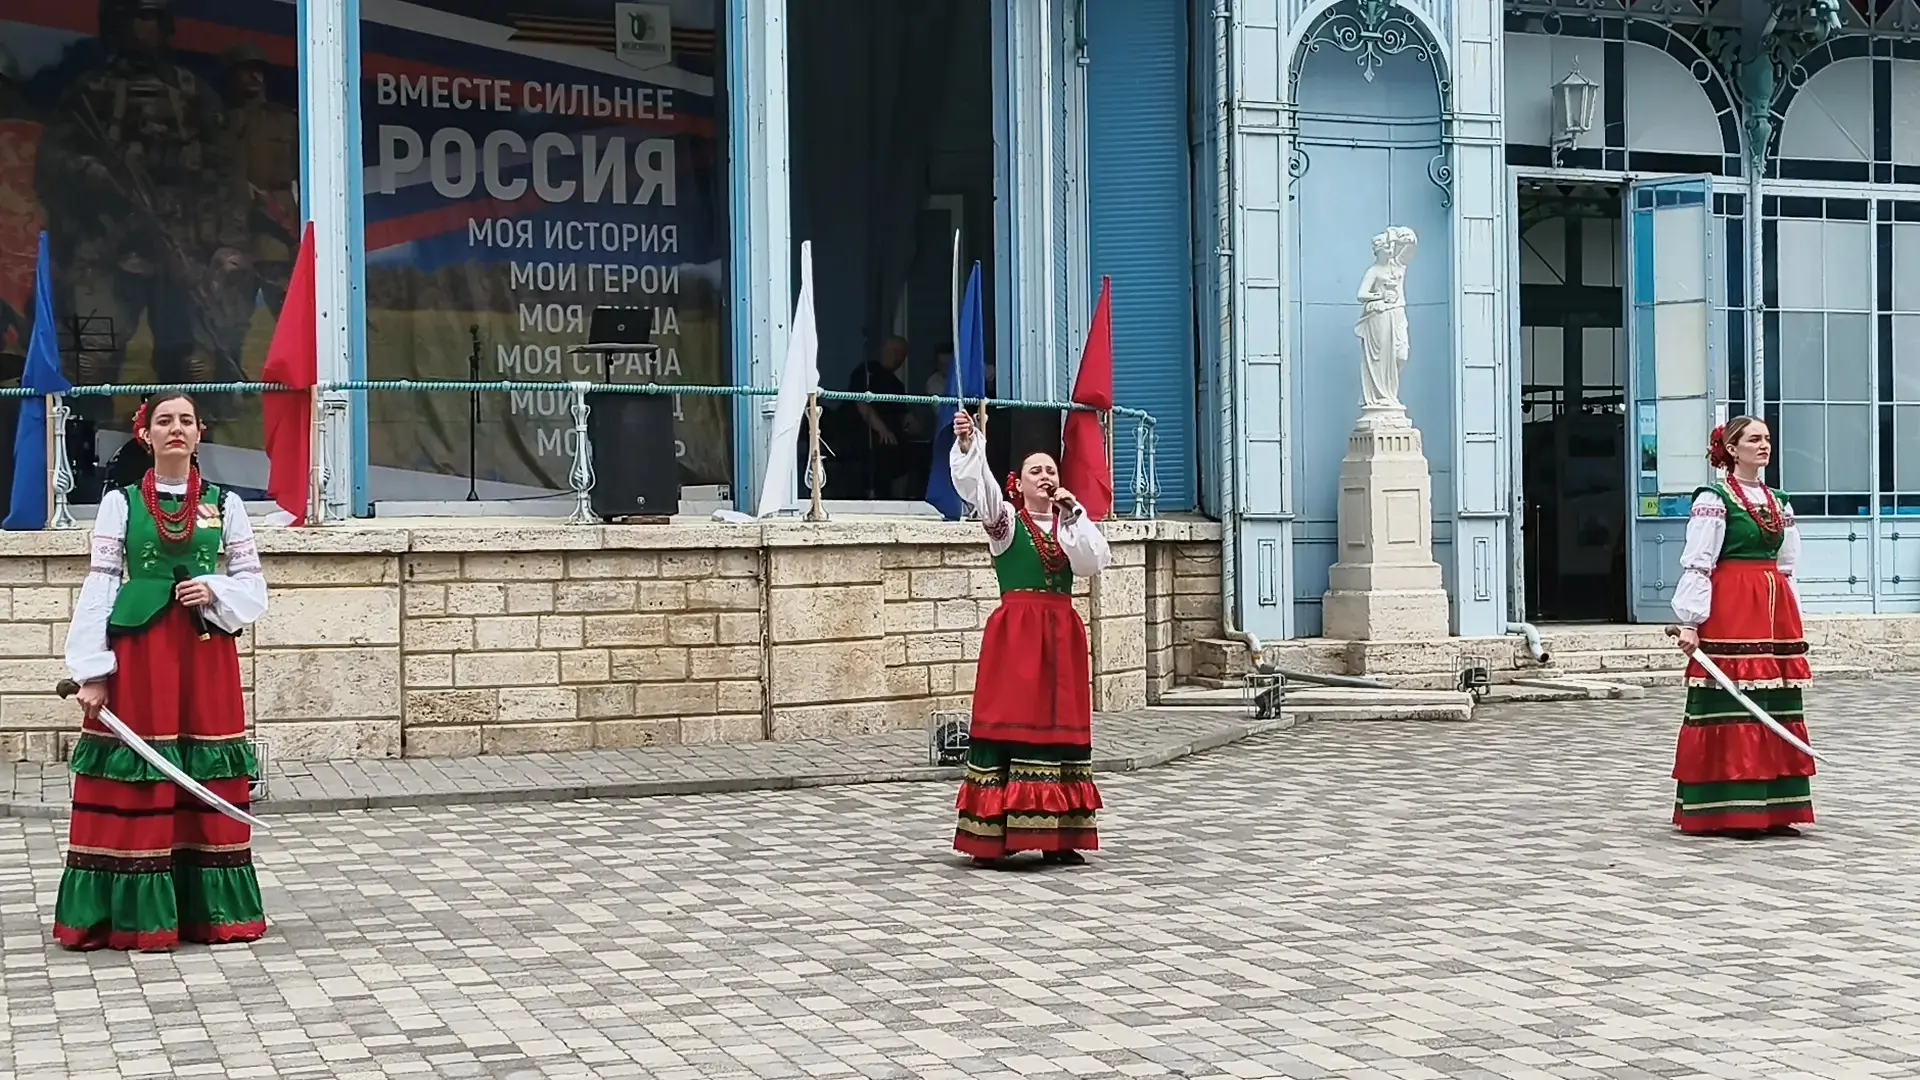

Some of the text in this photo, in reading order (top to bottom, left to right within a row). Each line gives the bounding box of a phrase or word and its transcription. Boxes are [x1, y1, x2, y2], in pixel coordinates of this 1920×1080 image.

[377, 73, 674, 120] ВМЕСТЕ СИЛЬНЕЕ
[378, 124, 677, 206] РОССИЯ
[469, 217, 678, 253] МОЯ ИСТОРИЯ
[510, 261, 679, 295] МОИ ГЕРОИ
[519, 303, 583, 333] МОЯ
[497, 344, 562, 375] МОЯ
